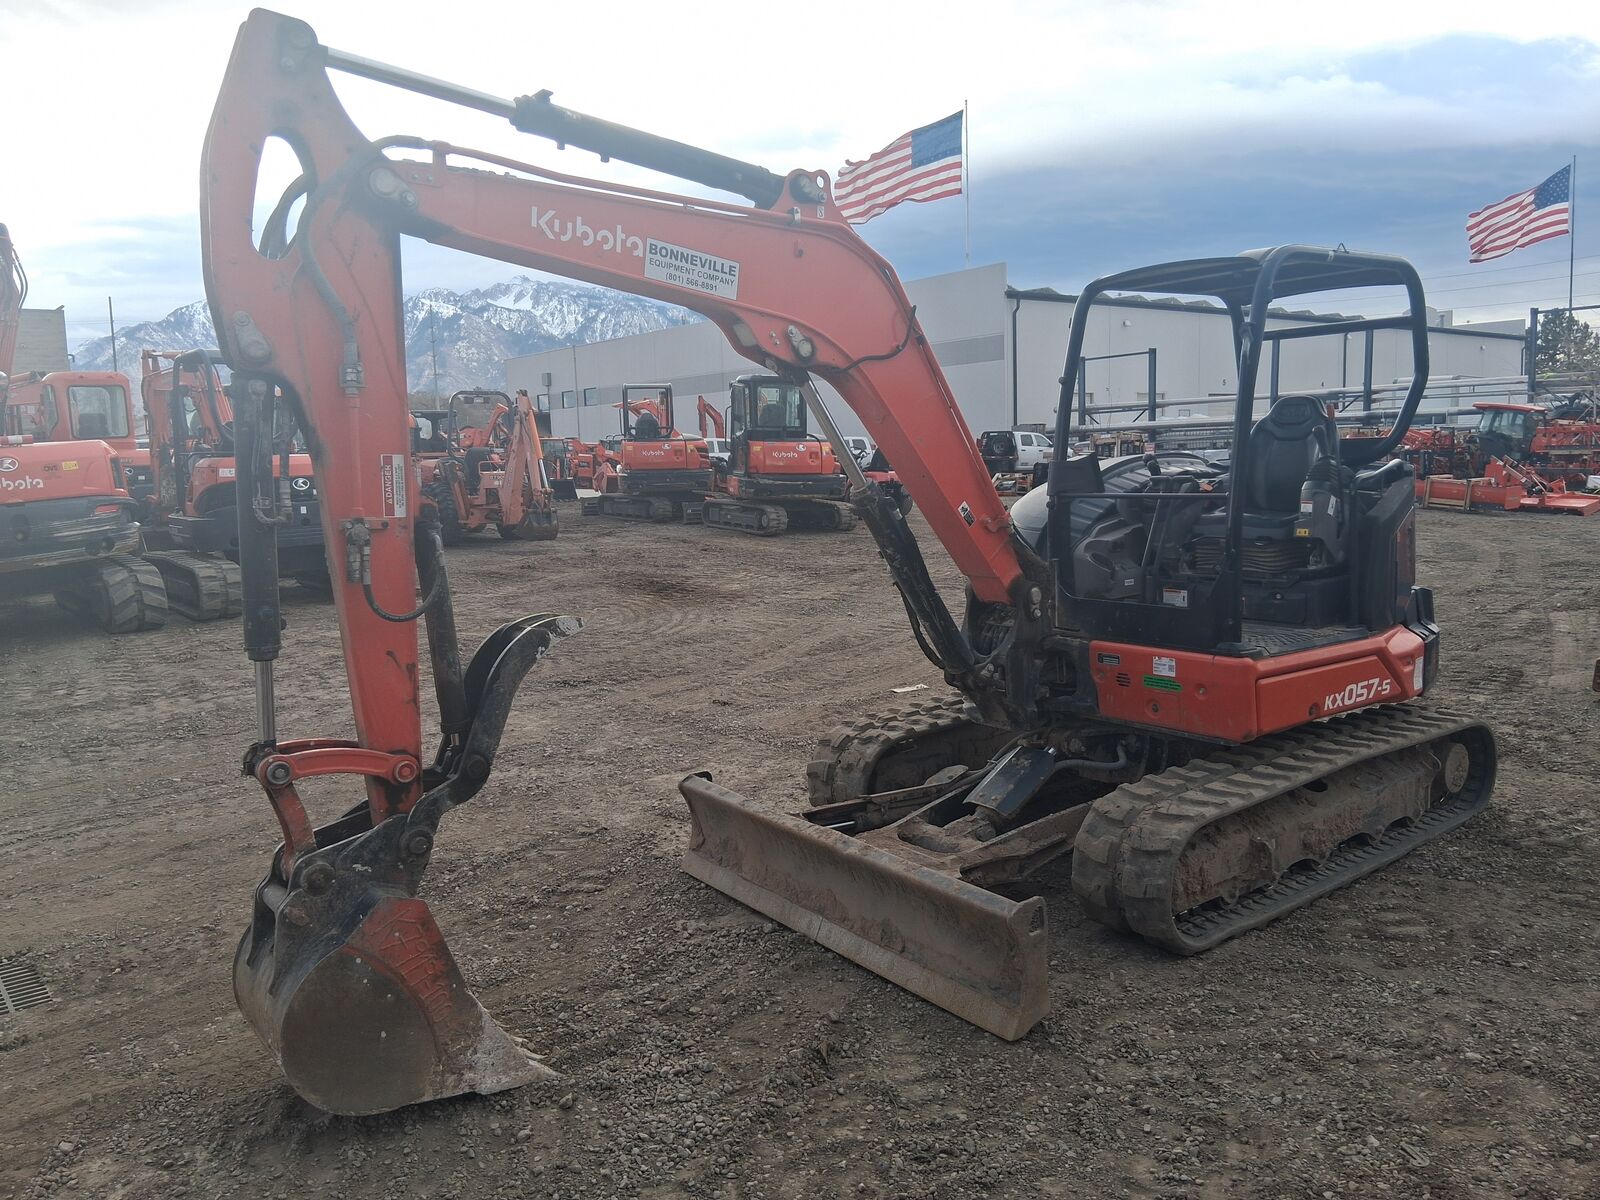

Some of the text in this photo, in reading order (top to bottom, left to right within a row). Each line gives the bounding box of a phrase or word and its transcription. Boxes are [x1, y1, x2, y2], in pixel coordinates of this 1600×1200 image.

[531, 206, 643, 257] Kubota
[648, 242, 737, 278] BONNEVILLE
[649, 258, 735, 287] EQUIPMENT COMPANY
[665, 272, 718, 292] (801) 566-8891
[641, 449, 665, 457] Kubota
[772, 451, 798, 459] Kubota
[0, 475, 44, 491] bota
[384, 464, 393, 498] DANGER
